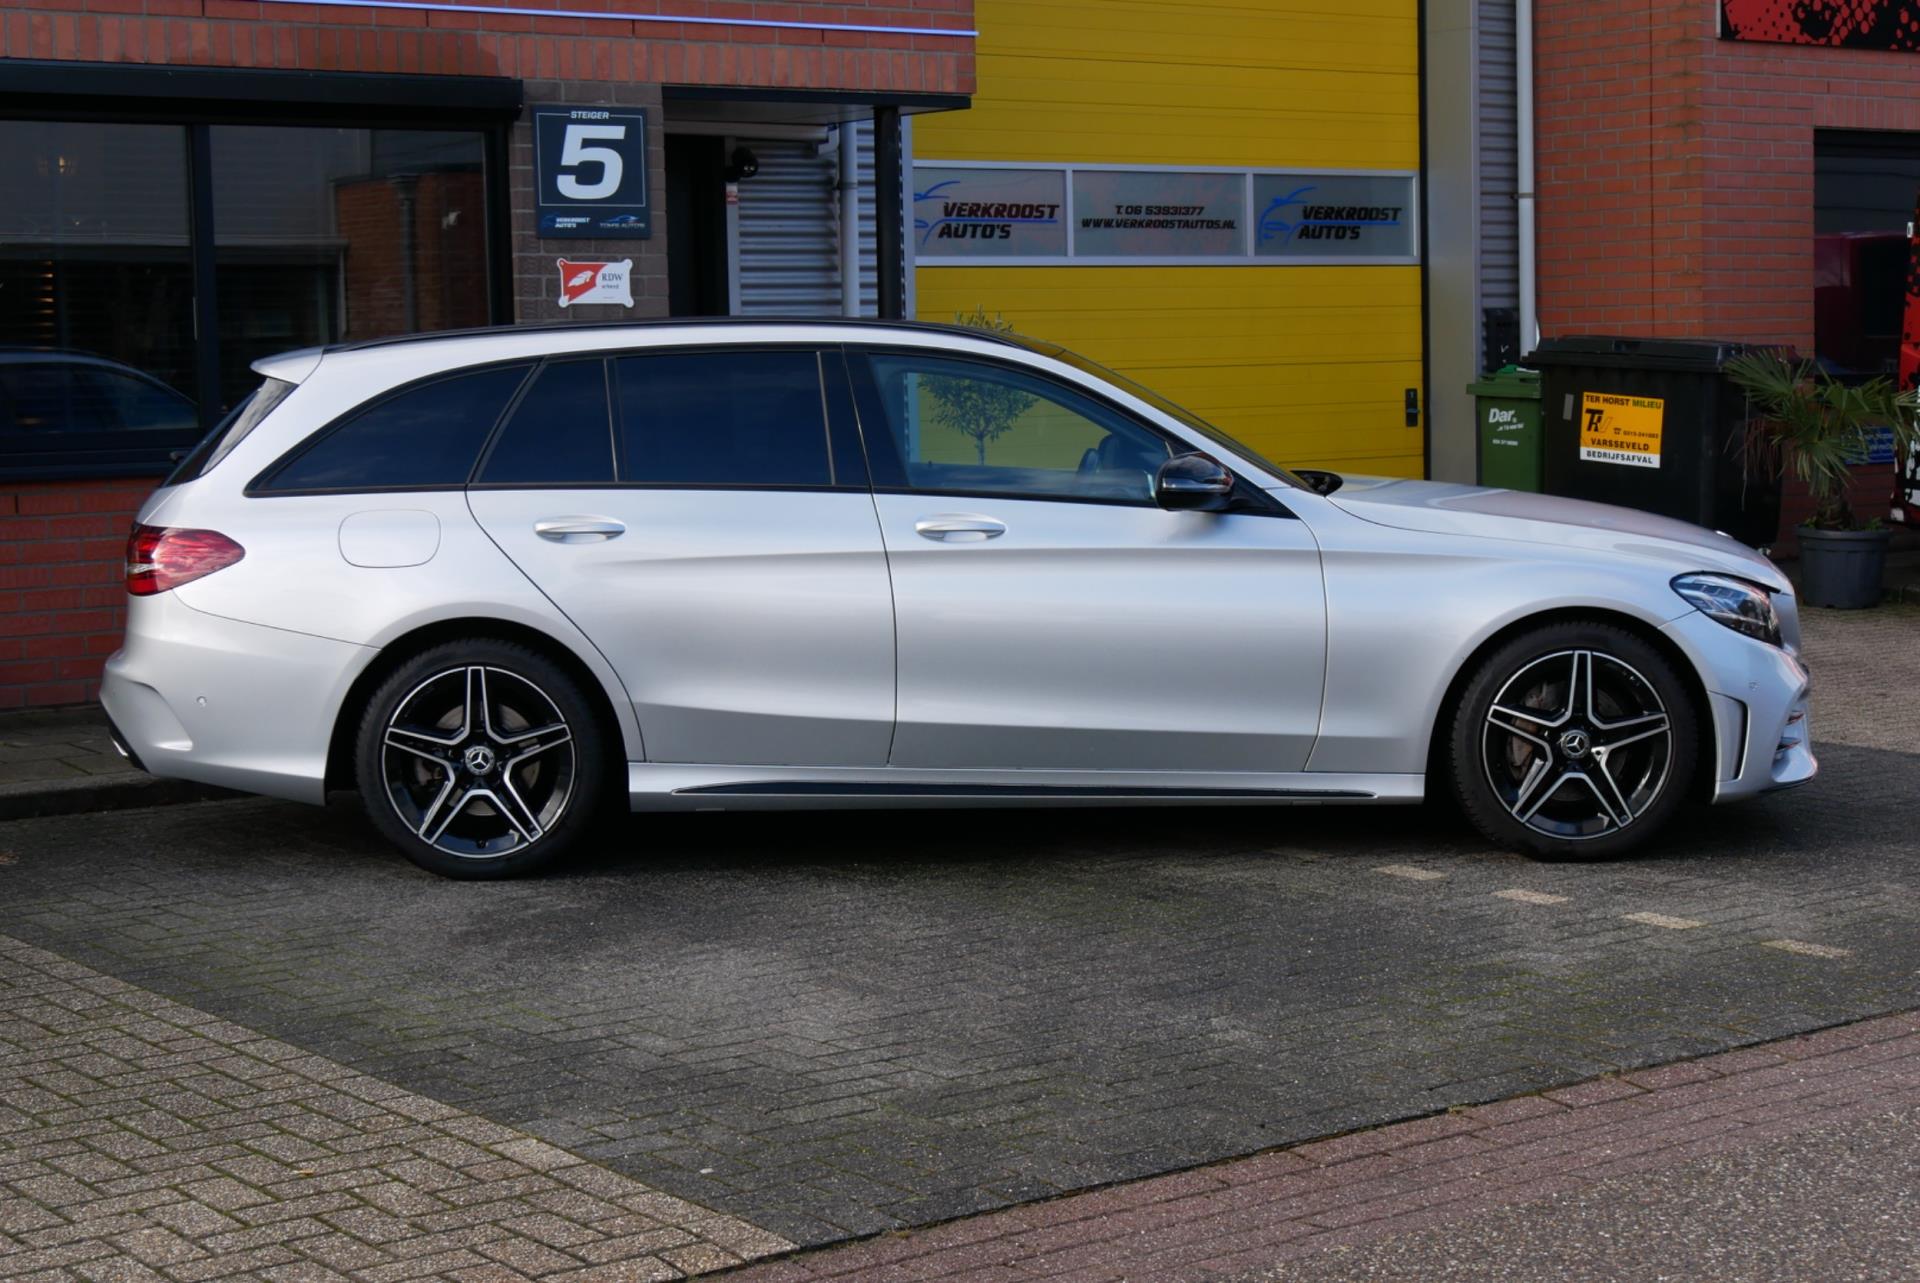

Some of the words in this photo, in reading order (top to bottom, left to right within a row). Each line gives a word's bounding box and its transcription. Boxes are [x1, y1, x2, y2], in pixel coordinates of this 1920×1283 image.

[570, 111, 609, 119] STEIGER
[557, 124, 626, 199] 5
[944, 202, 1060, 219] VERKROOST
[1124, 205, 1143, 216] 06
[1302, 206, 1402, 221] VERKROOST
[1082, 218, 1237, 229] WWW.VERKROOSTAUTOS.NL
[938, 223, 1012, 239] AUTO'S
[1298, 225, 1361, 240] AUTO'S
[601, 272, 623, 281] RDW
[1586, 395, 1600, 403] TER
[1602, 396, 1630, 406] HORST
[1631, 399, 1662, 409] MILIEU
[1591, 438, 1650, 451] VARSSEVELD
[1586, 450, 1653, 464] BEDRIJFSAFVAL
